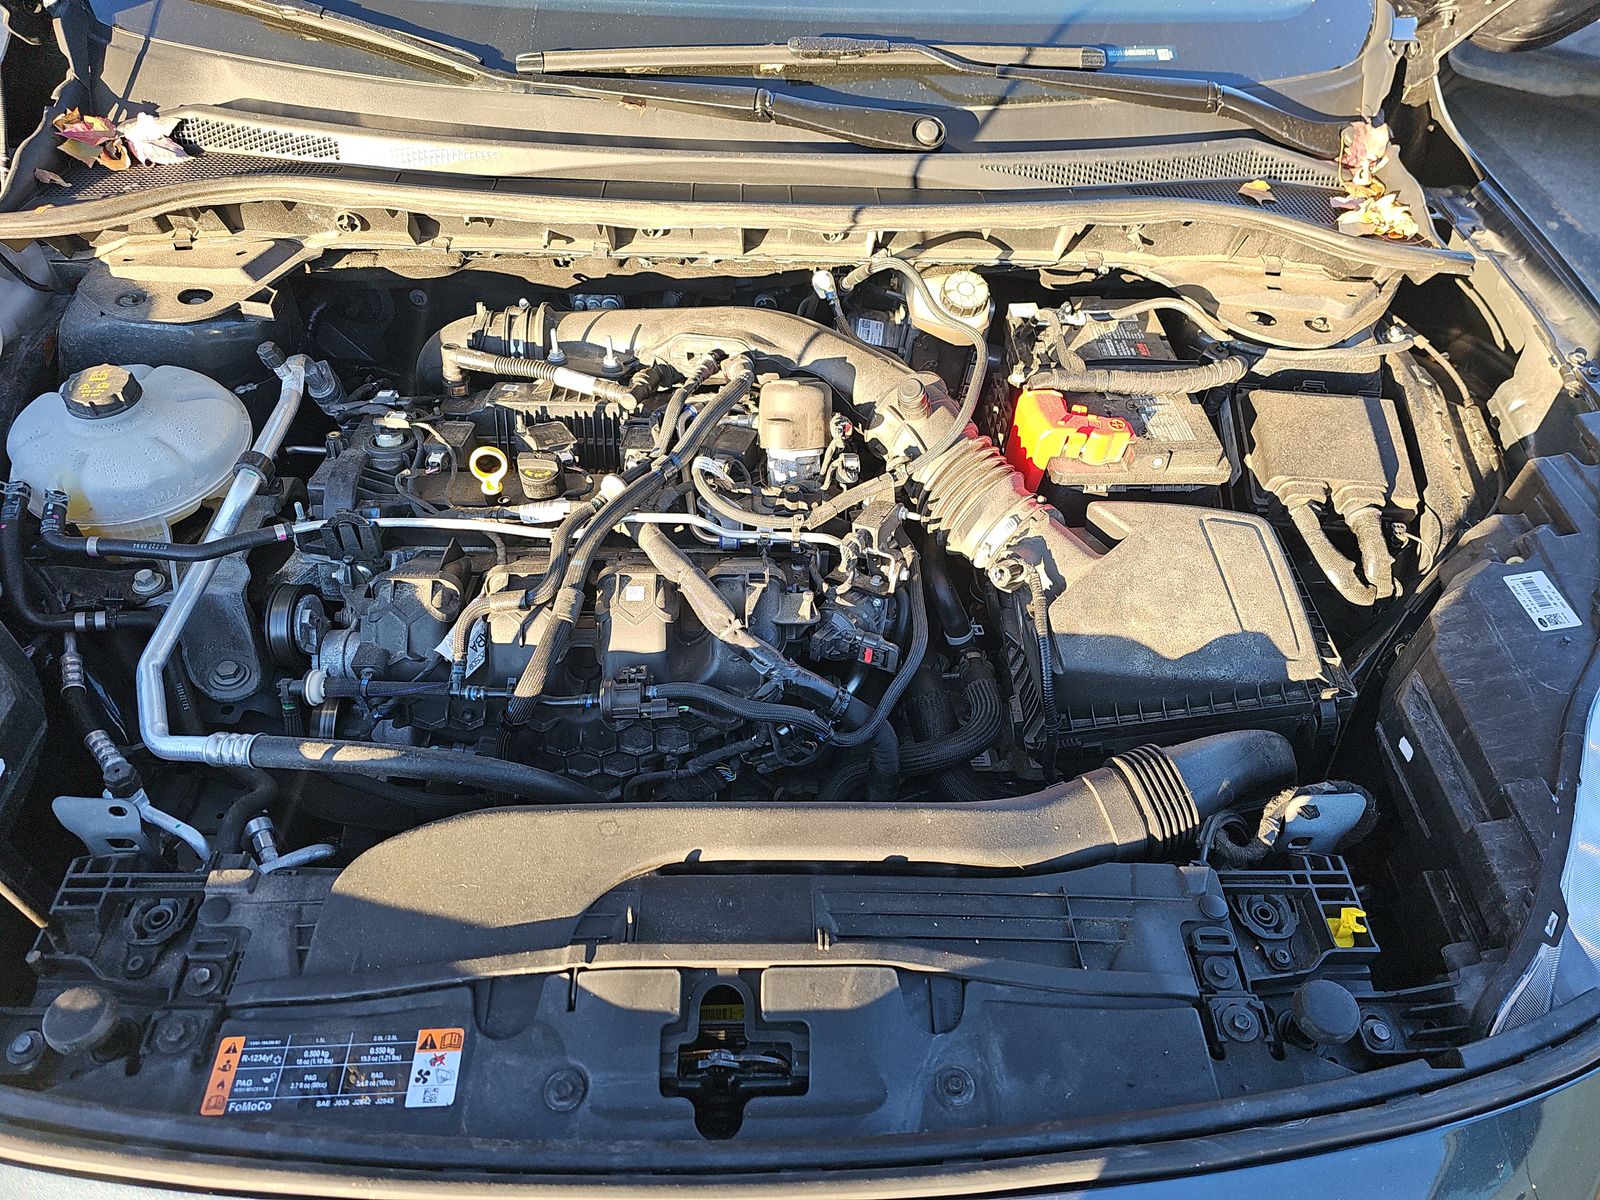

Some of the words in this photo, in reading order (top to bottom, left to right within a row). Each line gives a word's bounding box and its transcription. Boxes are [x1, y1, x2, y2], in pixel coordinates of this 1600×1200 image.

[321, 1049, 329, 1059] kg
[387, 1046, 396, 1055] kg
[241, 1053, 273, 1063] R-1234yf
[235, 1079, 253, 1087] PAG
[228, 1101, 272, 1112] FoMoCo
